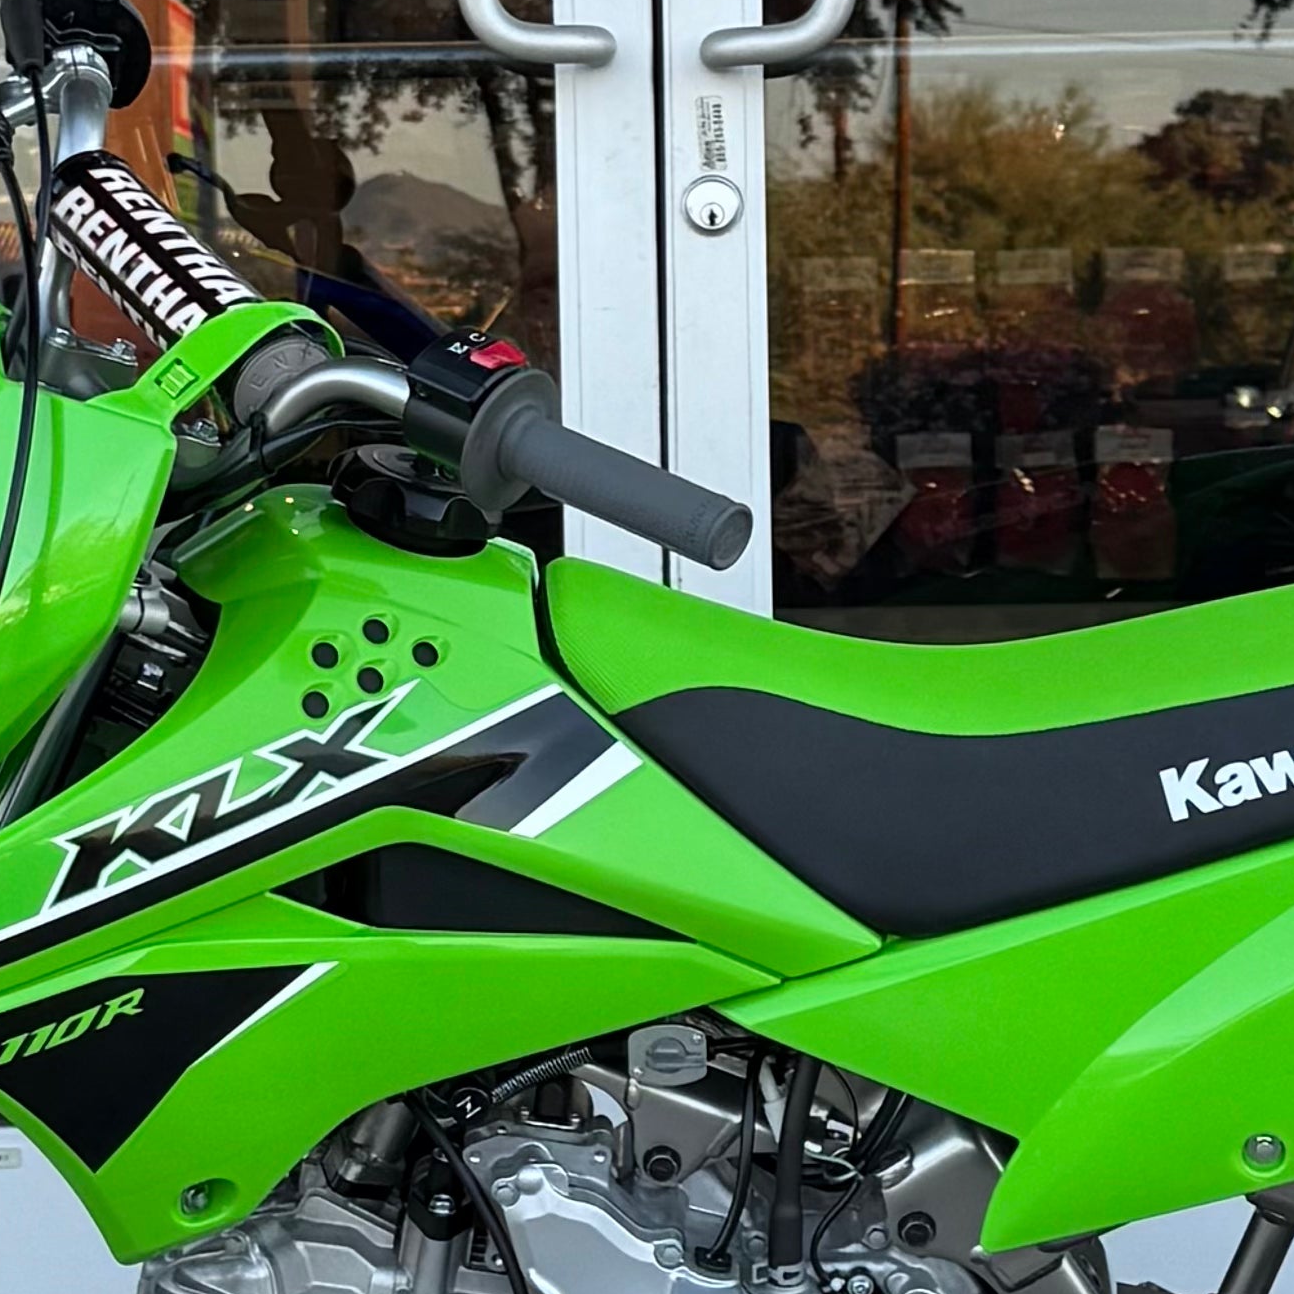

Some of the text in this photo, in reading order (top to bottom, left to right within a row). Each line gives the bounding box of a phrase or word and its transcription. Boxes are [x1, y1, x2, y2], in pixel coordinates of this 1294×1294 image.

[53, 184, 209, 337] RENTHA
[86, 166, 257, 307] RENTHA
[42, 679, 417, 913] KLX
